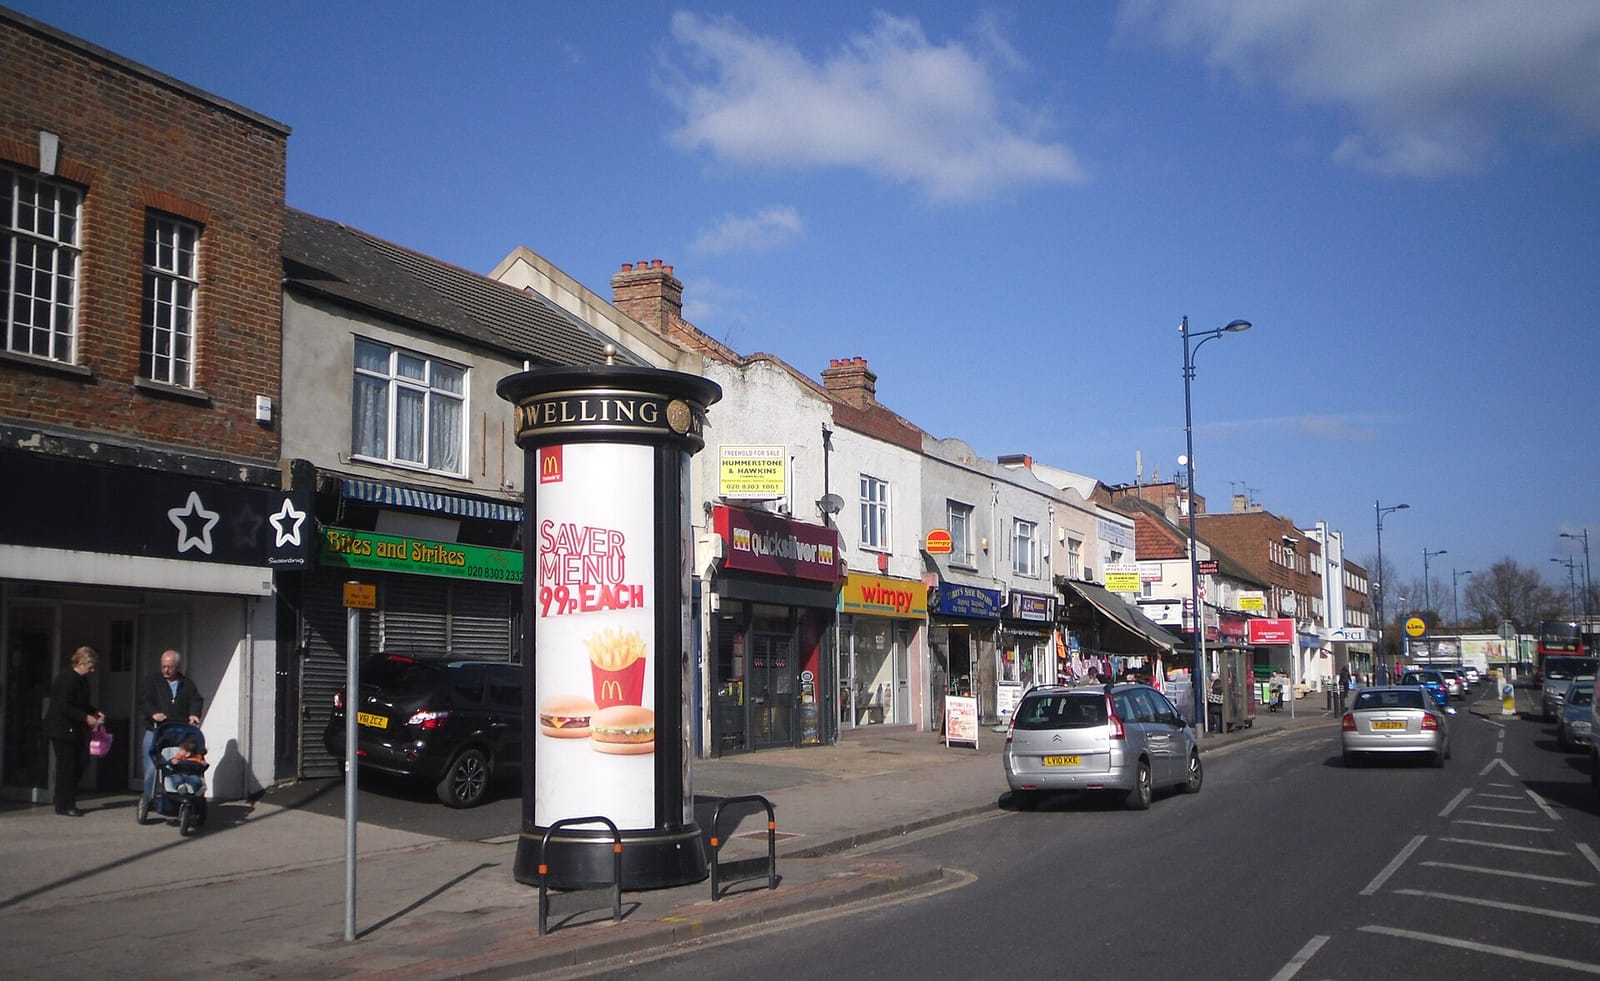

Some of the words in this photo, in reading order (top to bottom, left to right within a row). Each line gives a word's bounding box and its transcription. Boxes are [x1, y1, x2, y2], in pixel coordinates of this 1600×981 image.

[526, 399, 659, 427] WELLING
[722, 459, 783, 467] HUMMERSTONE
[754, 449, 765, 457] FOR
[766, 449, 780, 457] SALE
[327, 528, 371, 556] Bites
[377, 540, 407, 559] and
[412, 542, 465, 567] Strikes
[540, 519, 625, 559] SAVER
[752, 530, 818, 563] quicksilver
[467, 566, 483, 577] 020
[485, 567, 504, 580] 8303
[540, 552, 625, 587] MENU
[579, 584, 644, 612] EACH
[861, 582, 913, 613] wimpy
